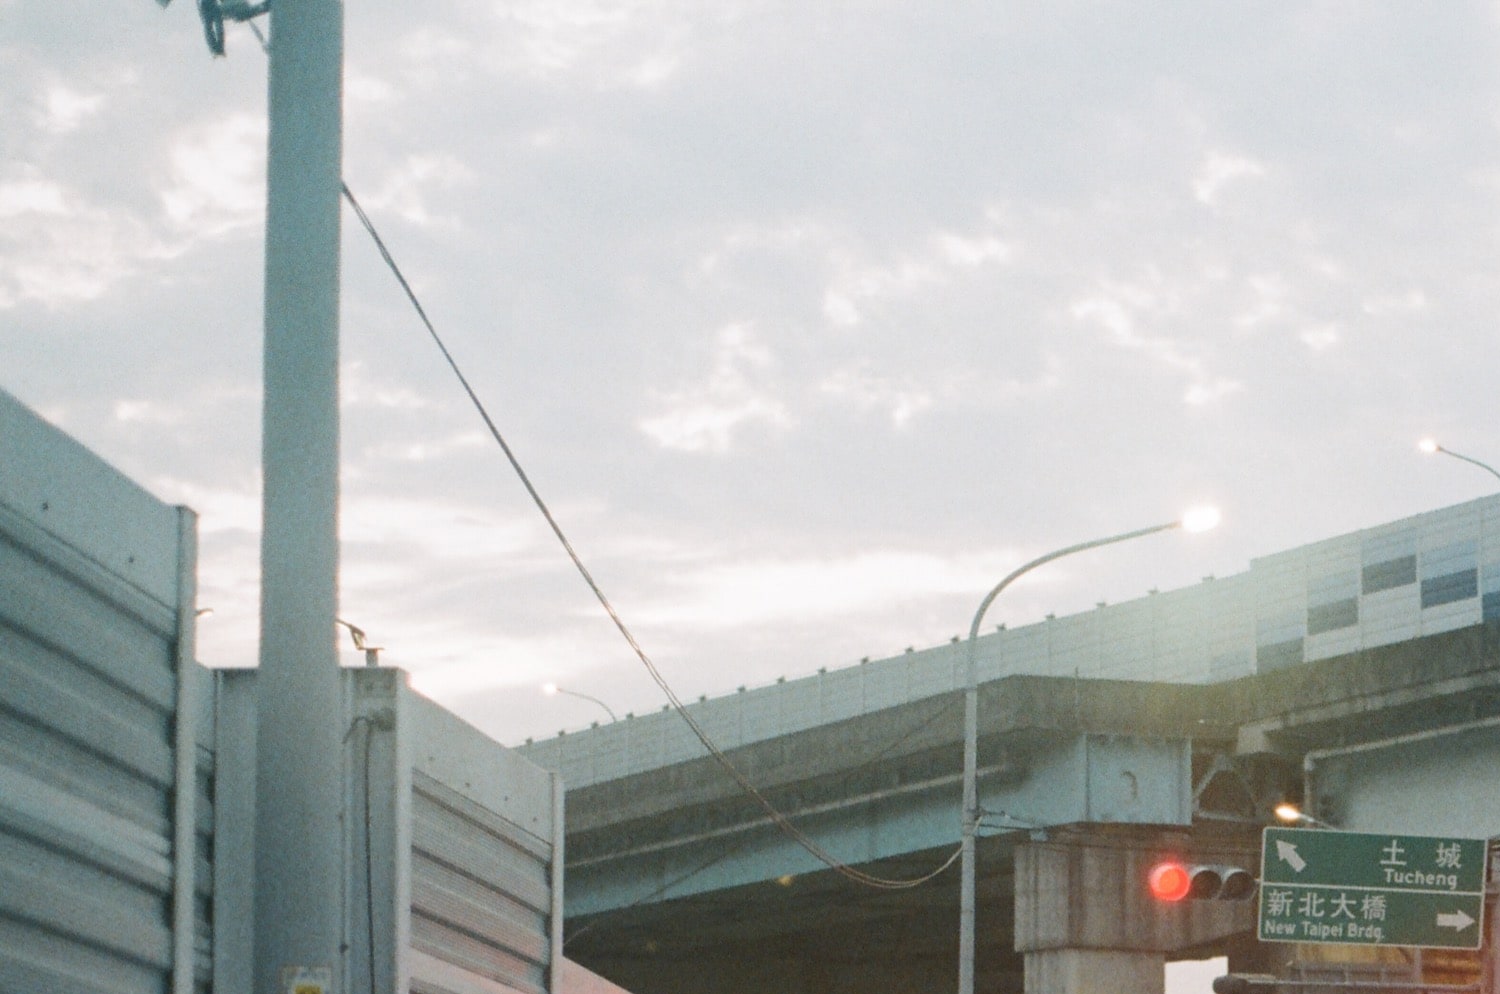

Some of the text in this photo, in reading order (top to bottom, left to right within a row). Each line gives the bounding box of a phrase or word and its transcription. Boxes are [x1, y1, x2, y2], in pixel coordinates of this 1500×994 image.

[1380, 839, 1462, 869] 土城
[1383, 868, 1458, 890] Tucheng
[1267, 889, 1387, 921] 新北大橋
[1264, 920, 1386, 944] New Taipei Brdg.
